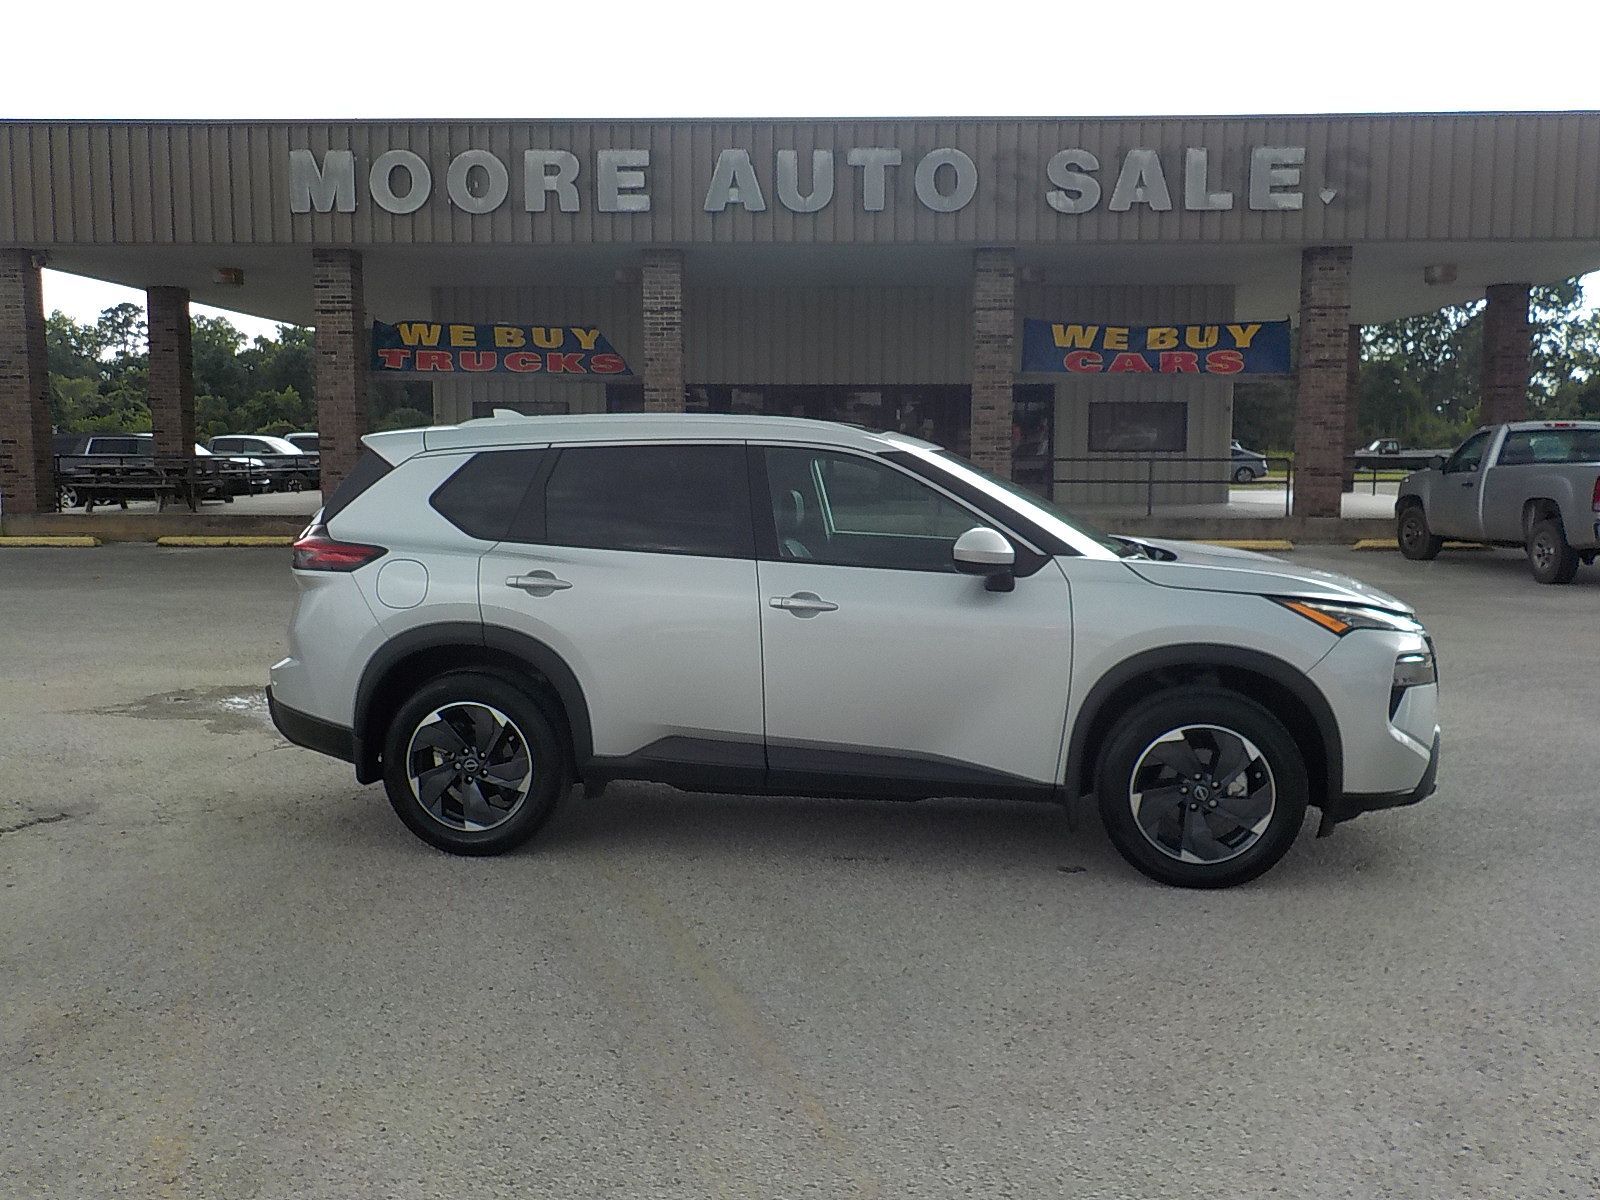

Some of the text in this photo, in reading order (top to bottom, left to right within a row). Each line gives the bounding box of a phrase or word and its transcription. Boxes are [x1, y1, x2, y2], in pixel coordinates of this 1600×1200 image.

[289, 149, 651, 214] MOORE
[703, 148, 979, 213] AUTO
[398, 323, 600, 350] WE BUY
[1051, 323, 1262, 350] WE BUY
[378, 349, 627, 375] TRUCKS
[1063, 350, 1245, 375] CARS
